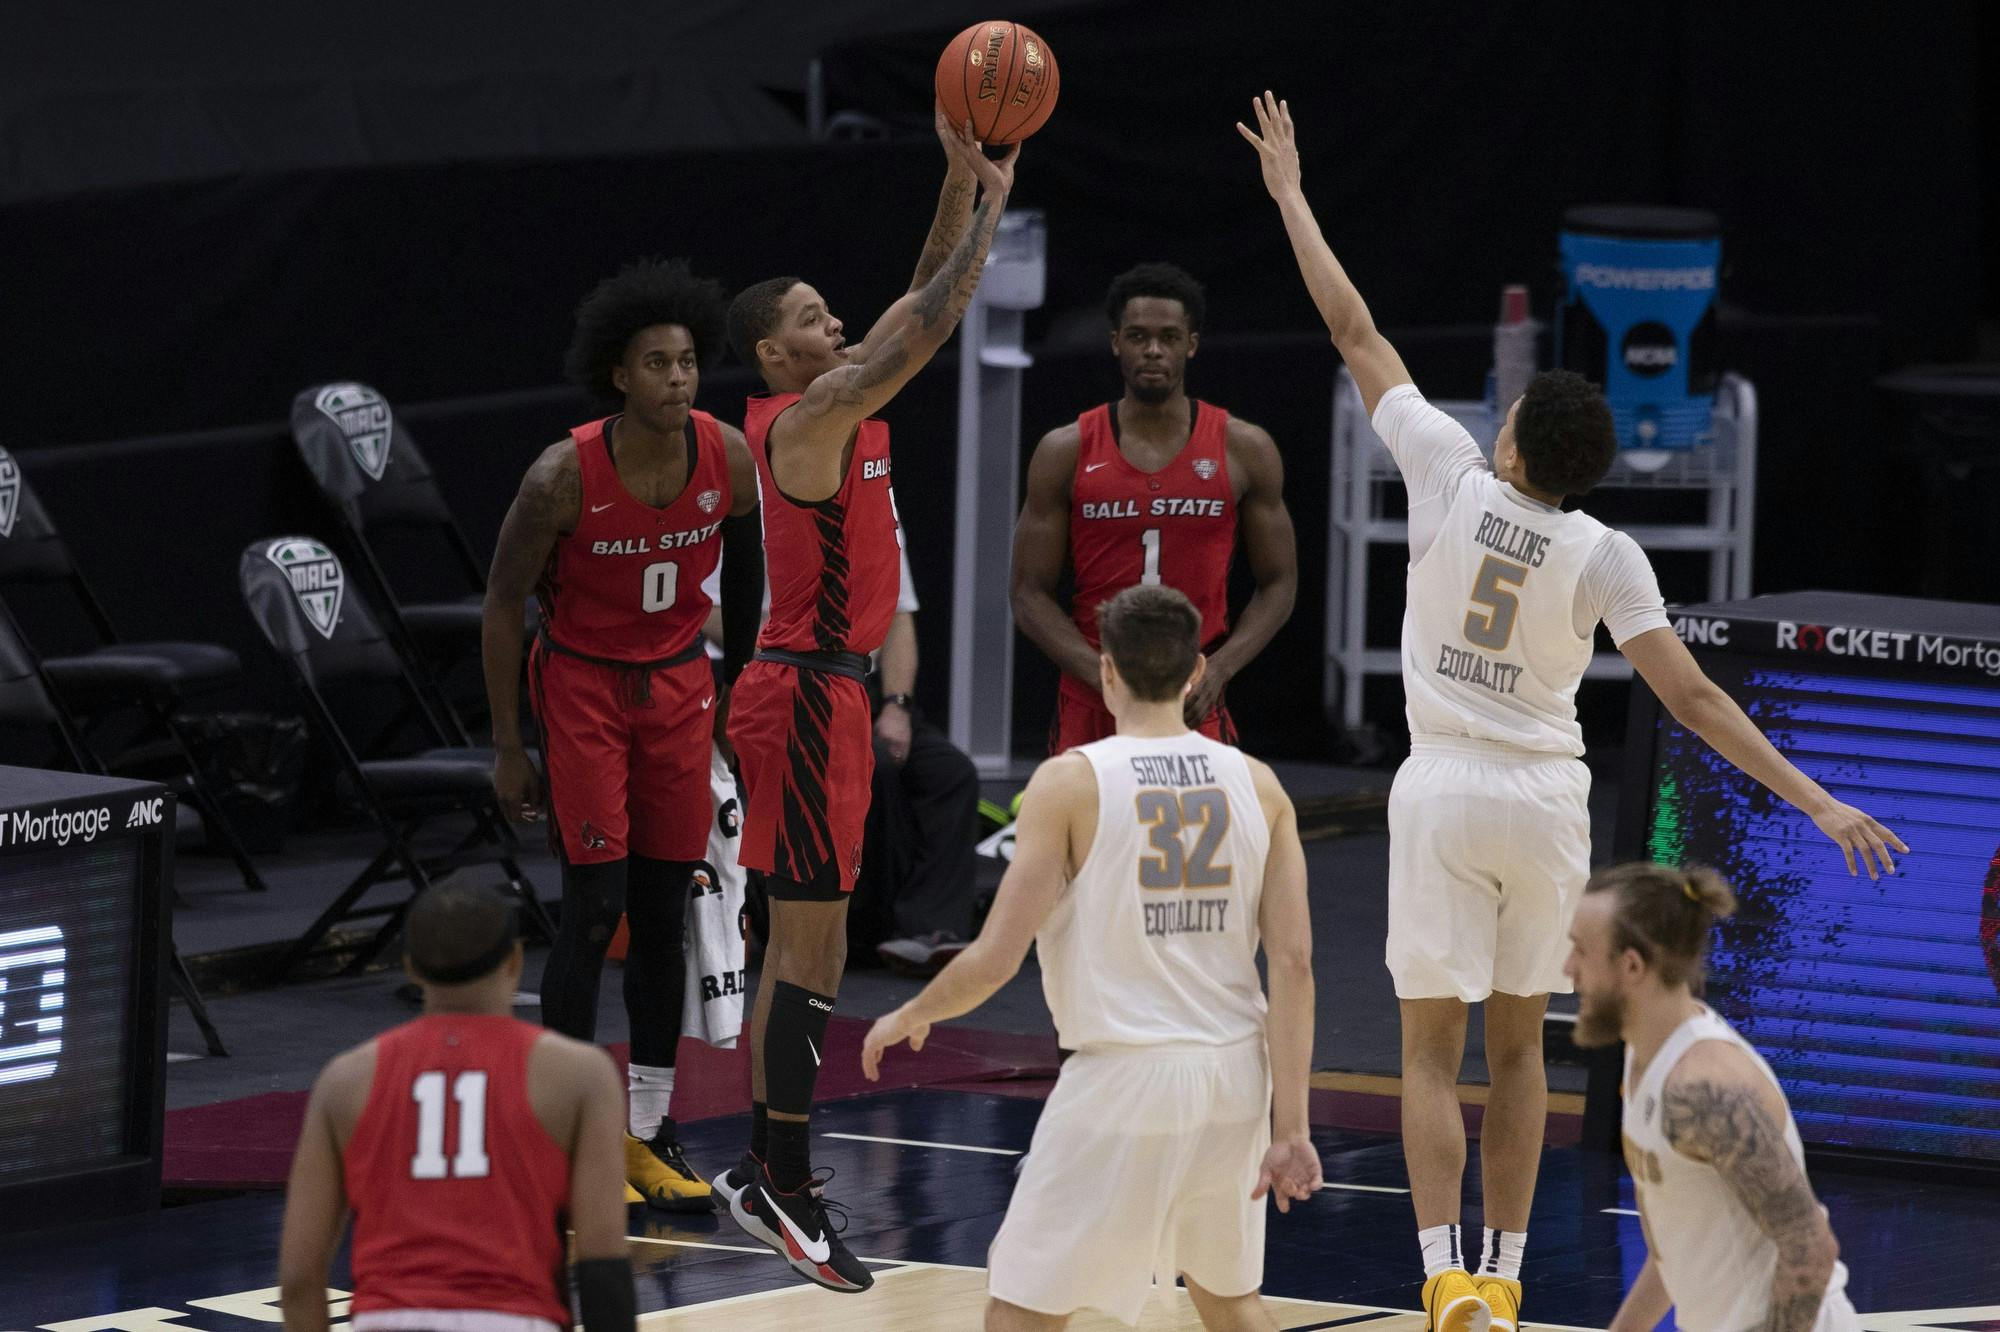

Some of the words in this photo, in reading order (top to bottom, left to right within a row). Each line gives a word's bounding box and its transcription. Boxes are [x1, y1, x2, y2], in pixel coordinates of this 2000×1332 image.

[1082, 499, 1140, 519] BALL
[1150, 498, 1225, 518] STATE
[591, 537, 651, 555] BALL
[1140, 528, 1162, 586] 1
[1474, 510, 1552, 569] ROLLINS
[288, 561, 341, 593] MAC
[642, 561, 679, 614] 0
[1462, 553, 1530, 652] 5
[1776, 620, 1912, 661] ROCKET
[1436, 643, 1524, 694] EQUALITY
[1131, 753, 1216, 786] SHUMATE
[12, 807, 111, 847] Mortgage
[126, 797, 164, 829] ANC
[1135, 787, 1233, 892] 32
[1143, 898, 1229, 937] EQUALITY
[808, 997, 834, 1012] PRO
[410, 1069, 491, 1180] 11
